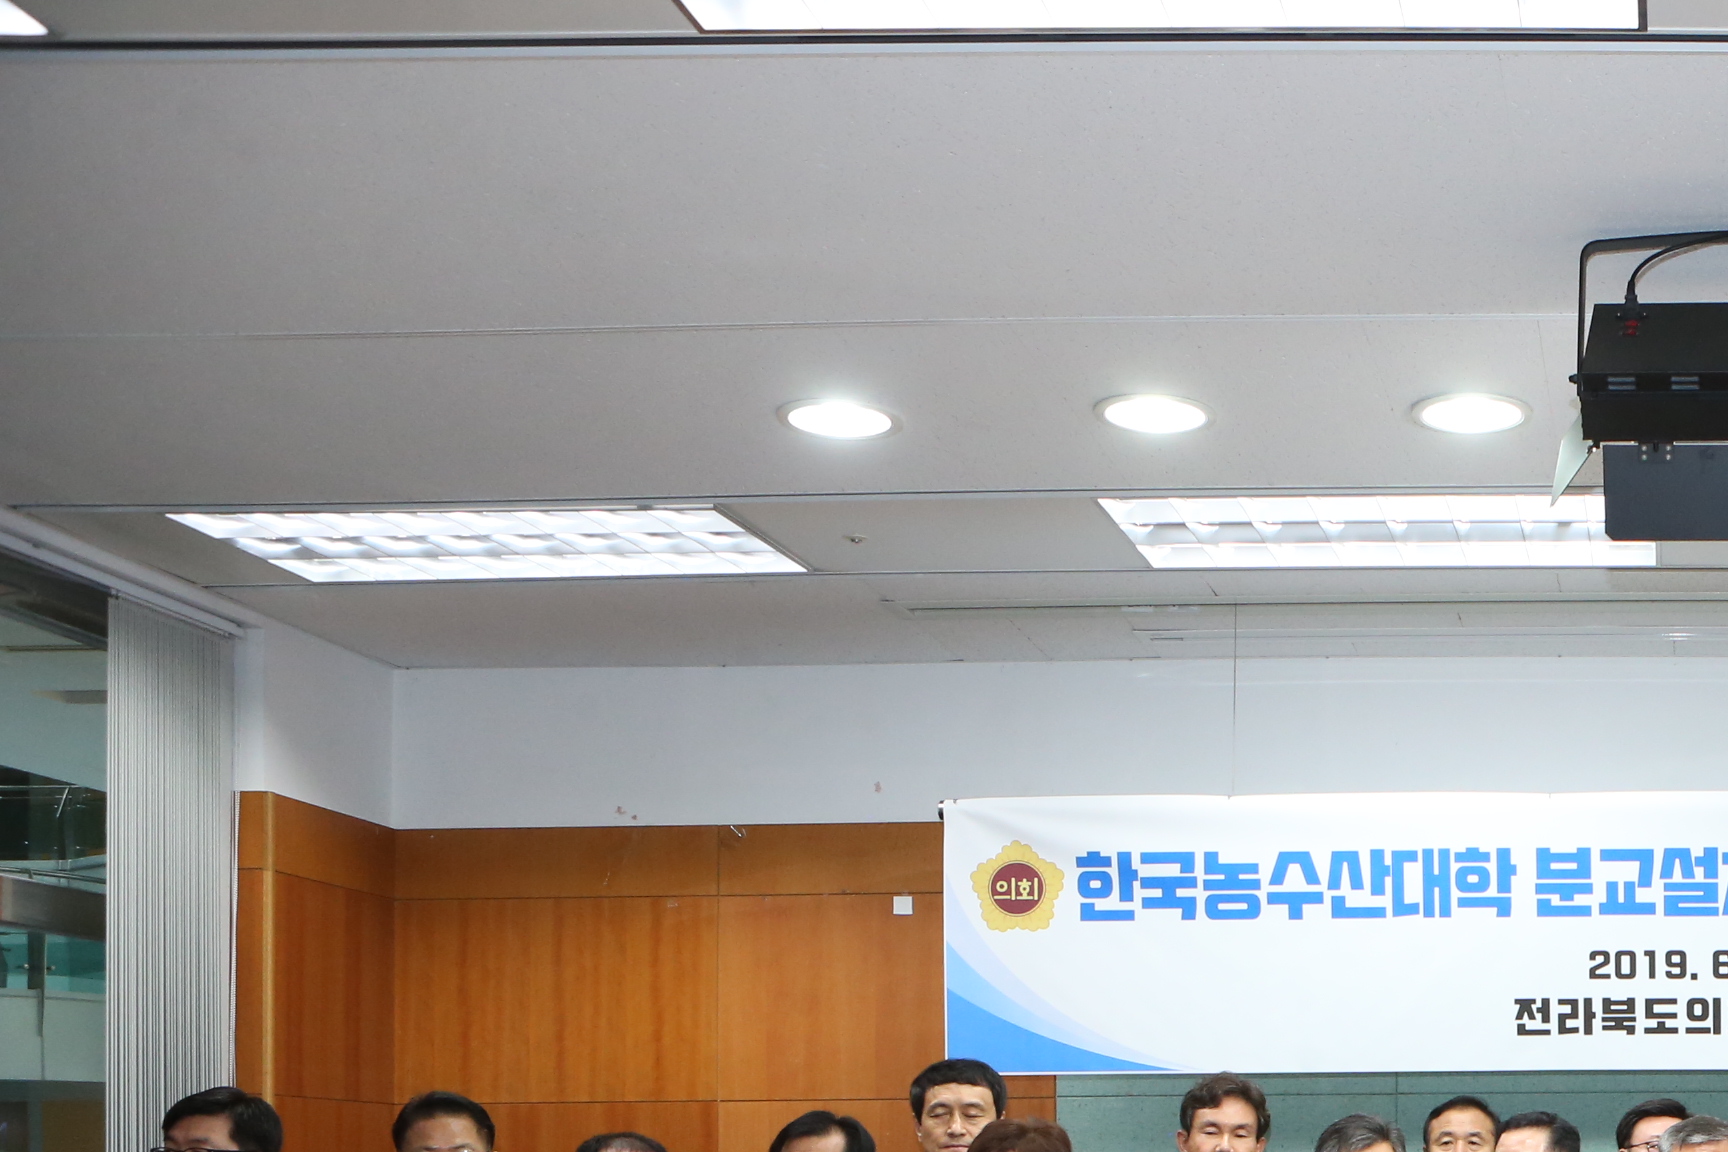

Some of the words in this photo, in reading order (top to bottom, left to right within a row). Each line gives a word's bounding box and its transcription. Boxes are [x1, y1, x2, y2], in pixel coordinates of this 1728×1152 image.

[993, 876, 1039, 901] 의회
[1075, 847, 1517, 922] 한국농수산대학
[1588, 949, 1698, 981] 2019.
